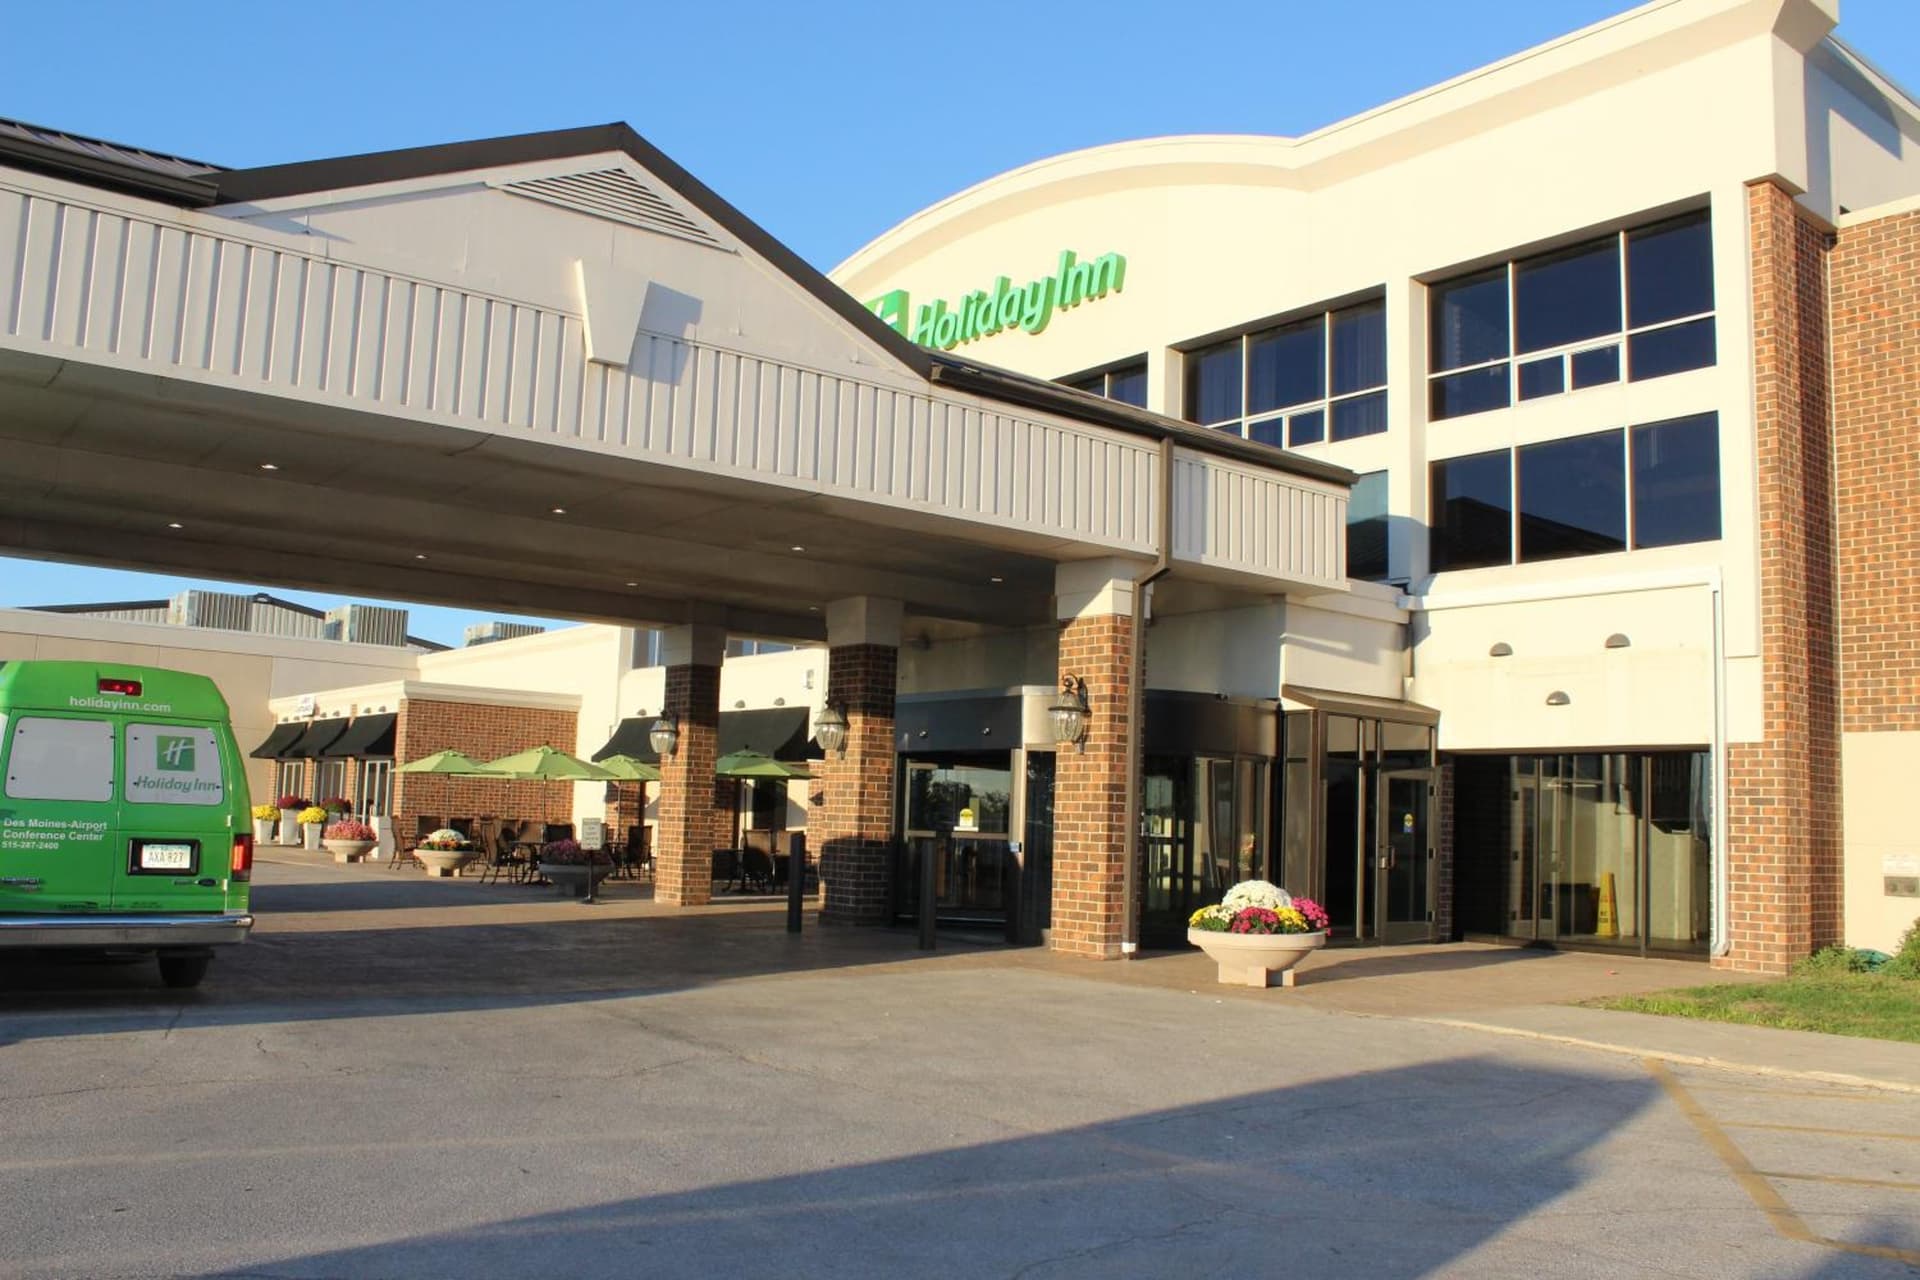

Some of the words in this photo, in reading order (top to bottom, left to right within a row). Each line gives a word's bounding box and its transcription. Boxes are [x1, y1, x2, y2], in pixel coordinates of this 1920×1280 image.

[911, 276, 1056, 350] Holiday
[1053, 249, 1126, 312] Inn
[69, 696, 171, 713] holidayinn.com
[136, 776, 193, 793] Holiday
[193, 778, 216, 792] Inn
[3, 817, 26, 827] Des
[28, 818, 108, 832] Moines-Airport
[3, 829, 66, 840] Conference
[68, 831, 104, 841] Center
